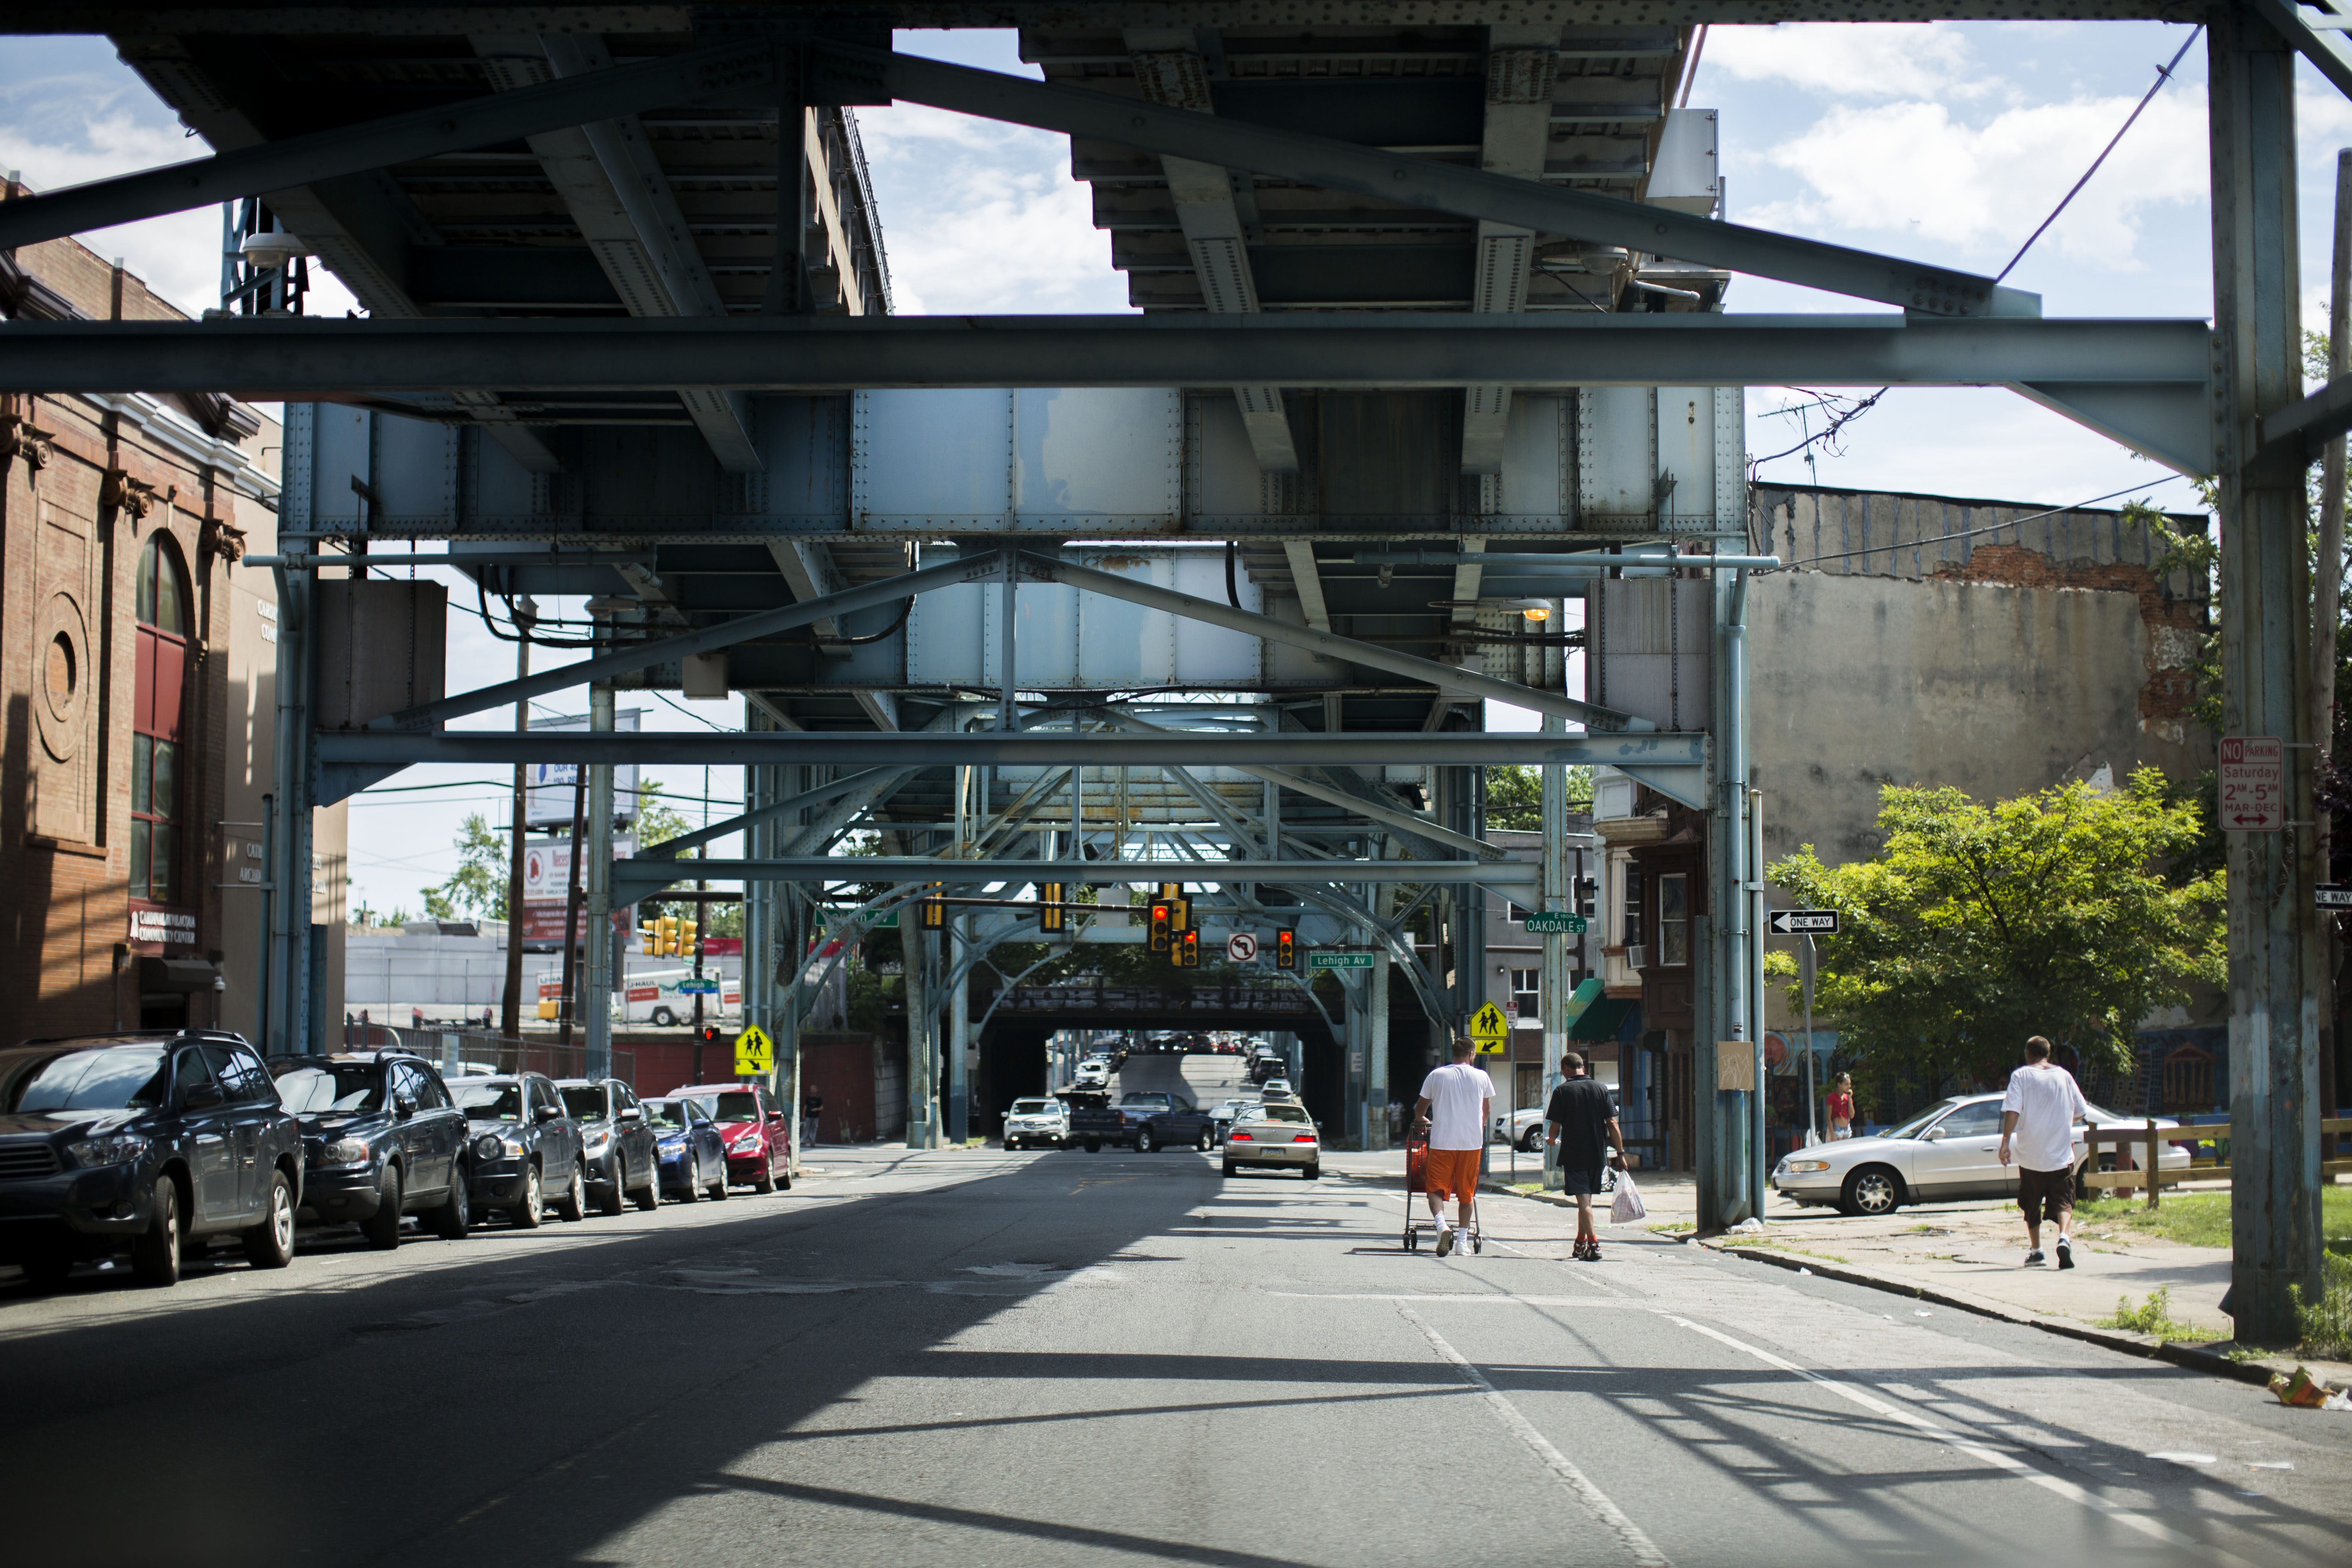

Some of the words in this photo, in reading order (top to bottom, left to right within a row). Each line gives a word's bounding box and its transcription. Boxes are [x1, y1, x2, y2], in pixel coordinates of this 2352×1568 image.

[2223, 743, 2241, 759] NO
[2245, 745, 2278, 757] PARKING
[2224, 766, 2279, 781] Saturday
[2225, 803, 2278, 812] MAR-DEC
[2315, 892, 2328, 902] NE
[2331, 892, 2352, 903] WAY
[140, 910, 166, 926] CARDINAL
[1791, 918, 1808, 927] ONE
[1812, 917, 1830, 926] WAY
[1528, 920, 1574, 932] OAKDALE
[139, 926, 174, 943] COMMUNITY
[174, 930, 196, 944] CENTER
[1317, 957, 1349, 966] Lehigh
